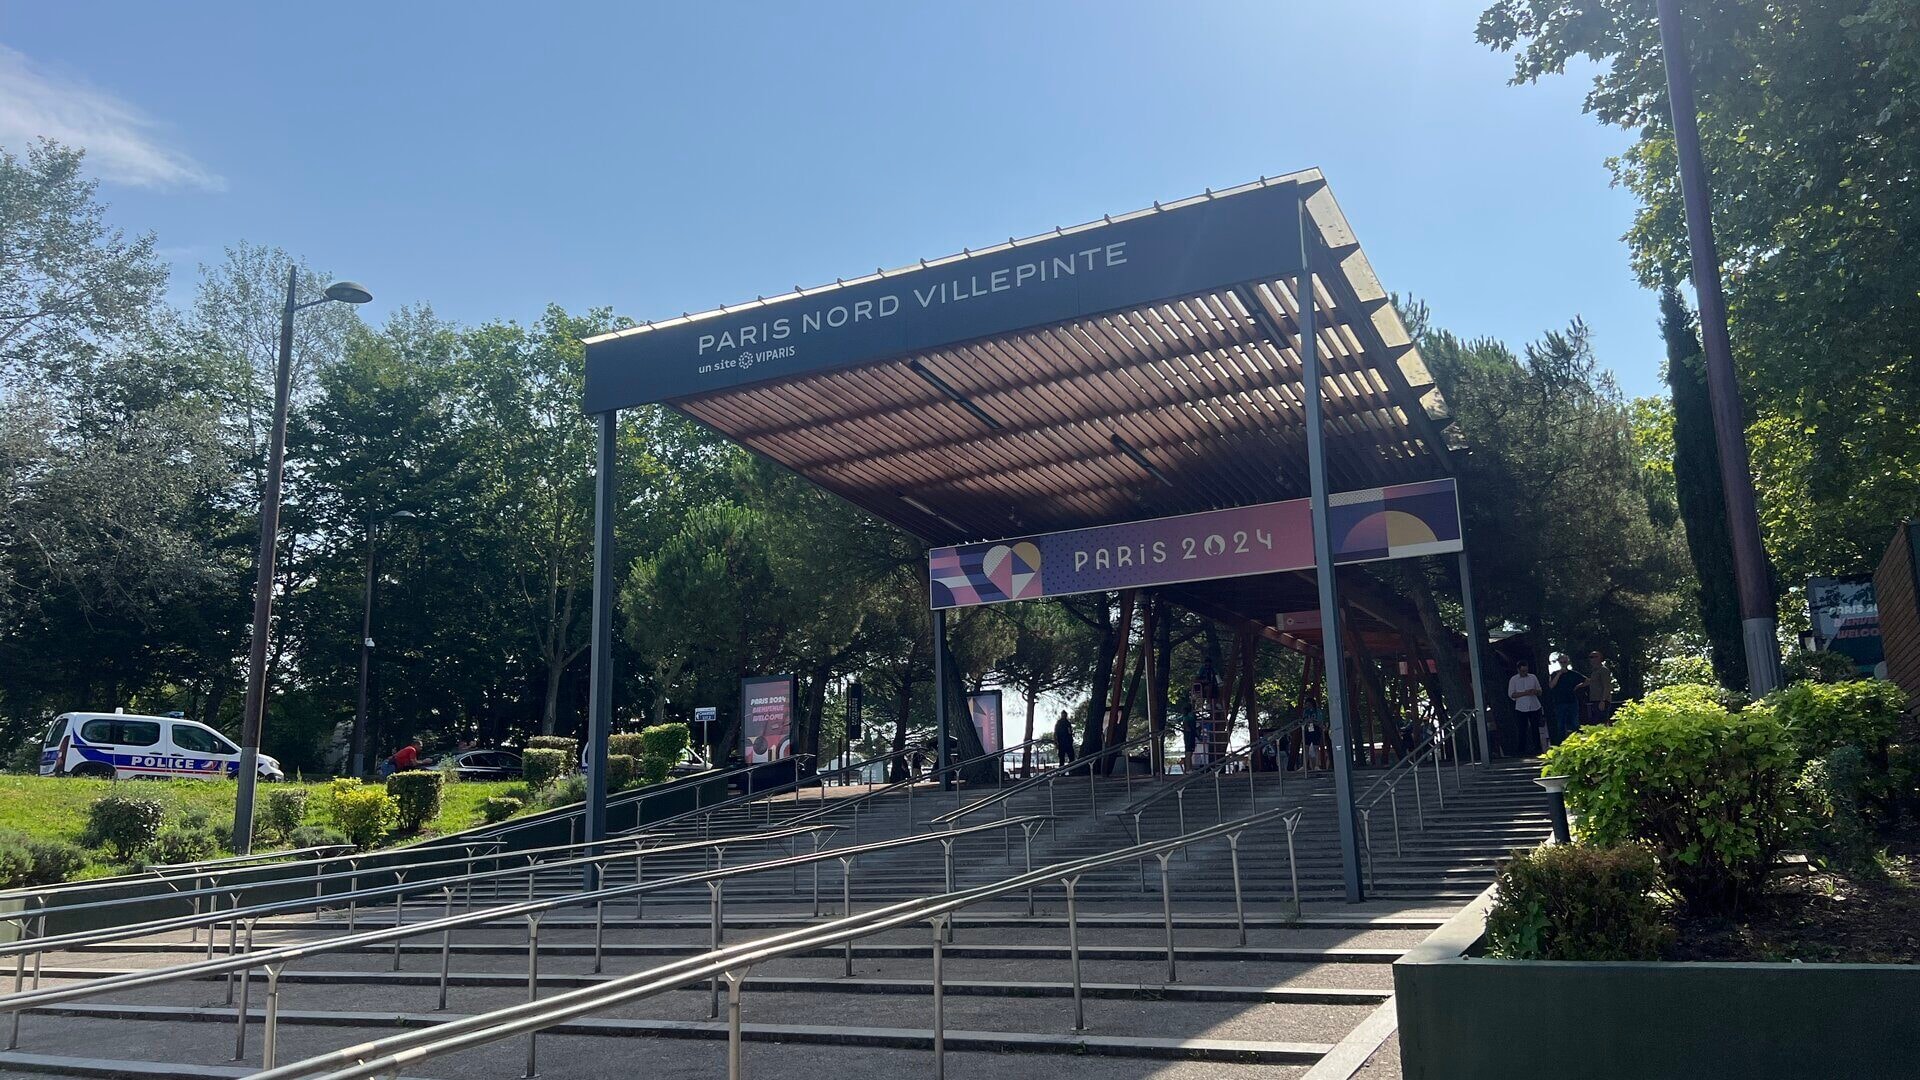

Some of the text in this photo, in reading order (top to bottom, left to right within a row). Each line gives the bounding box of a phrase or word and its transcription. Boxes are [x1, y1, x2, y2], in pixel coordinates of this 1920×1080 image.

[698, 241, 1128, 355] PARIS NORD VILLEPINTE
[698, 345, 796, 374] un site VIPARIS
[1181, 529, 1273, 560] 2024
[1828, 604, 1864, 616] PARIS
[131, 756, 195, 769] POLICE
